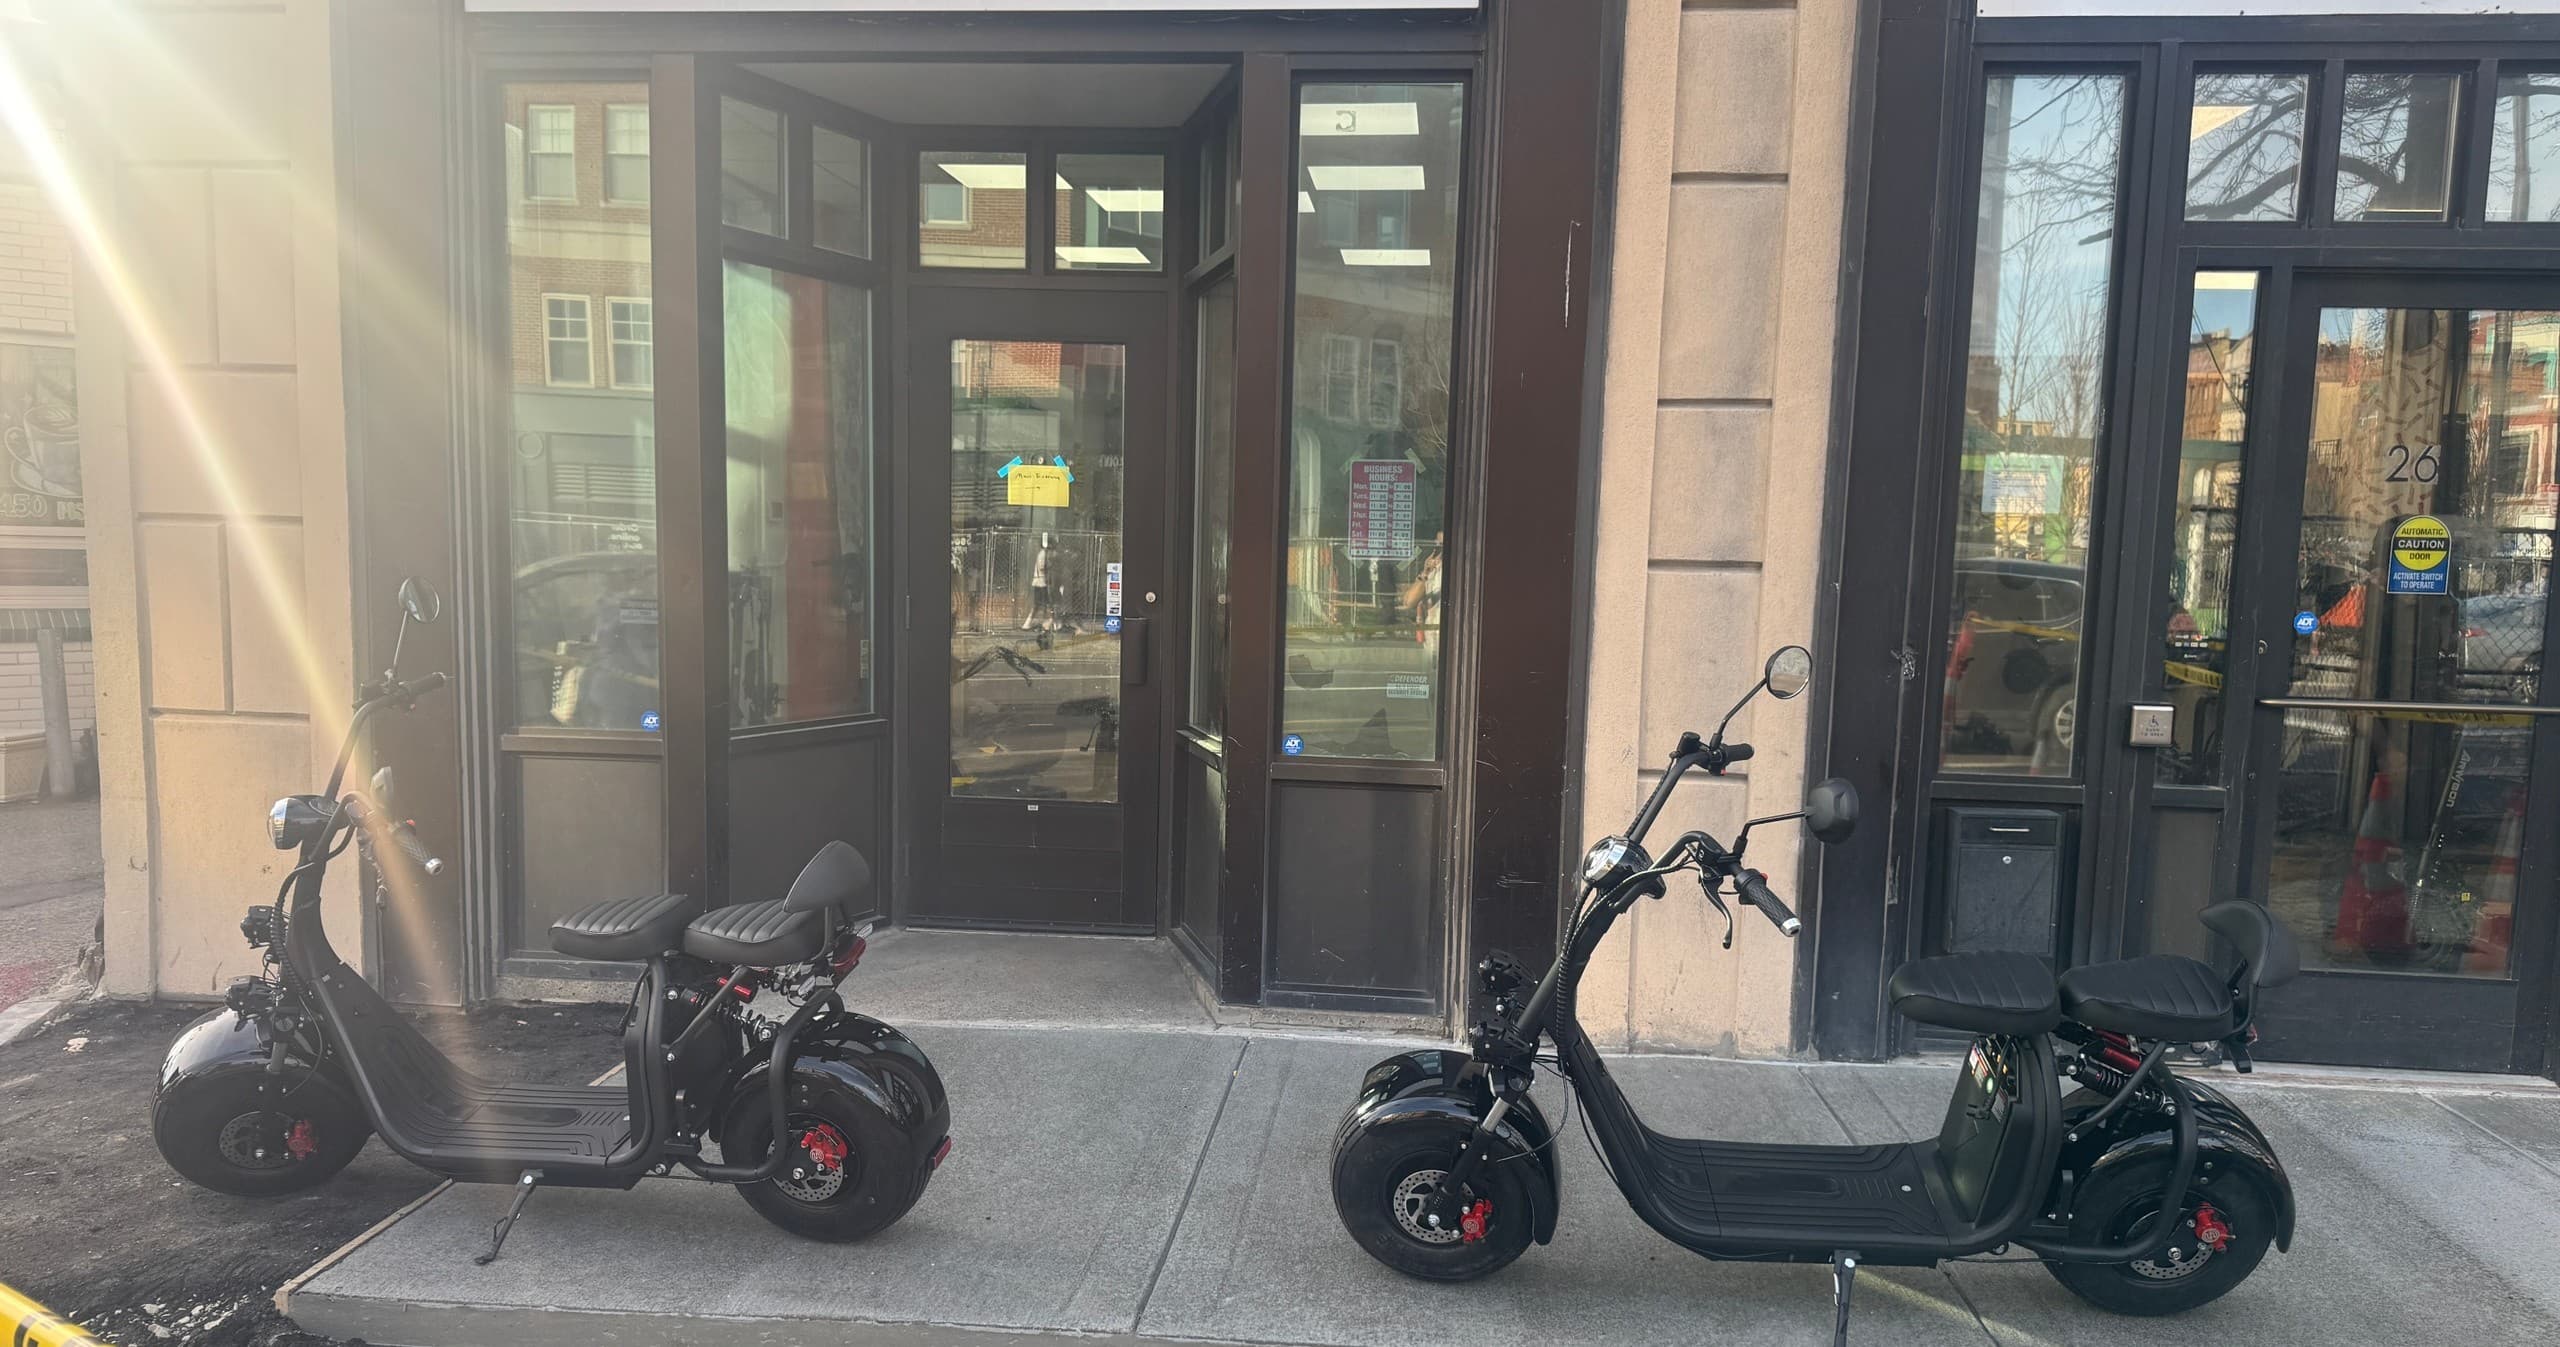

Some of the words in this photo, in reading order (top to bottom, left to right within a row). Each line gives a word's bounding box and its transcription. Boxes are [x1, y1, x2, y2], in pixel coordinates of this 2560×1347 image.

[2385, 445, 2438, 482] 26
[1364, 465, 1403, 474] BUSINESS
[1368, 473, 1399, 481] HOURS:
[2401, 527, 2443, 536] AUTOMATIC
[2398, 539, 2445, 549] CAUTION
[2409, 552, 2431, 561] DOOR
[2393, 571, 2420, 580] ACTIVATE
[2421, 573, 2443, 581] SWITCH
[2401, 580, 2408, 588] TO
[2409, 581, 2435, 589] OPERATE
[2296, 617, 2314, 626] ADT
[643, 716, 659, 724] ADT
[1285, 739, 1301, 747] ADT
